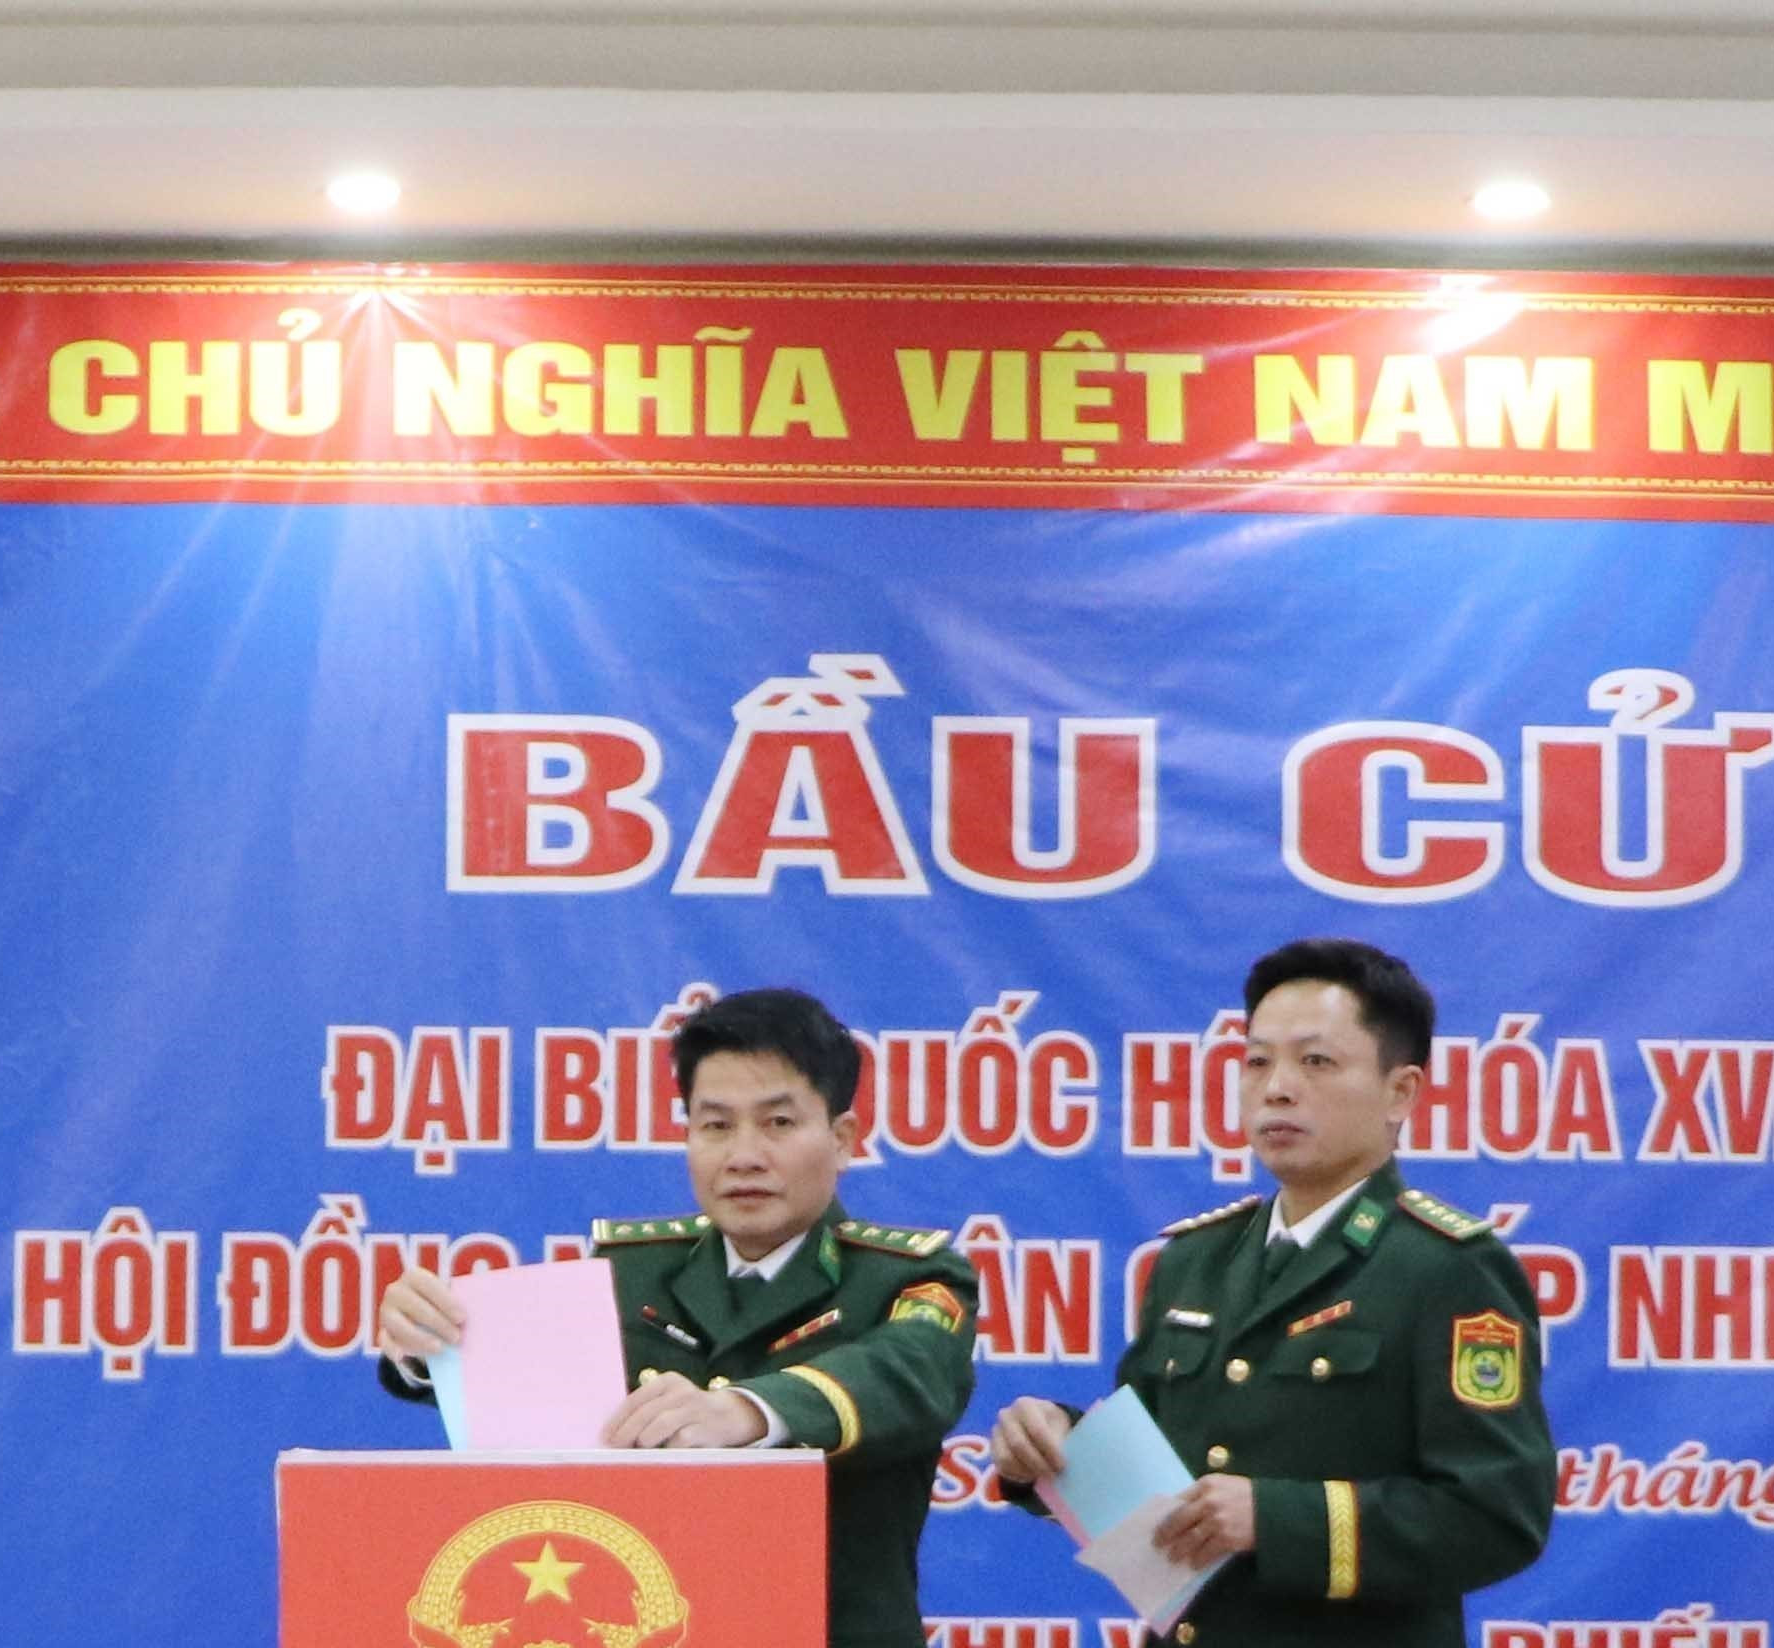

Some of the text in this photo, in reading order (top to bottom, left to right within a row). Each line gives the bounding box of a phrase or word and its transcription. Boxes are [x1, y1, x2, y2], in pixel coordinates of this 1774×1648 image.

[48, 307, 345, 438] CHỦ
[393, 327, 848, 440] NGHĨA
[896, 331, 1206, 465] VIỆT
[1255, 351, 1597, 456] NAM
[447, 653, 1157, 898] BẦU
[321, 1025, 512, 1174] ĐẠI
[1393, 1014, 1622, 1162] HÓA
[12, 1206, 199, 1380] HỘI
[955, 1213, 1103, 1364] ÂN
